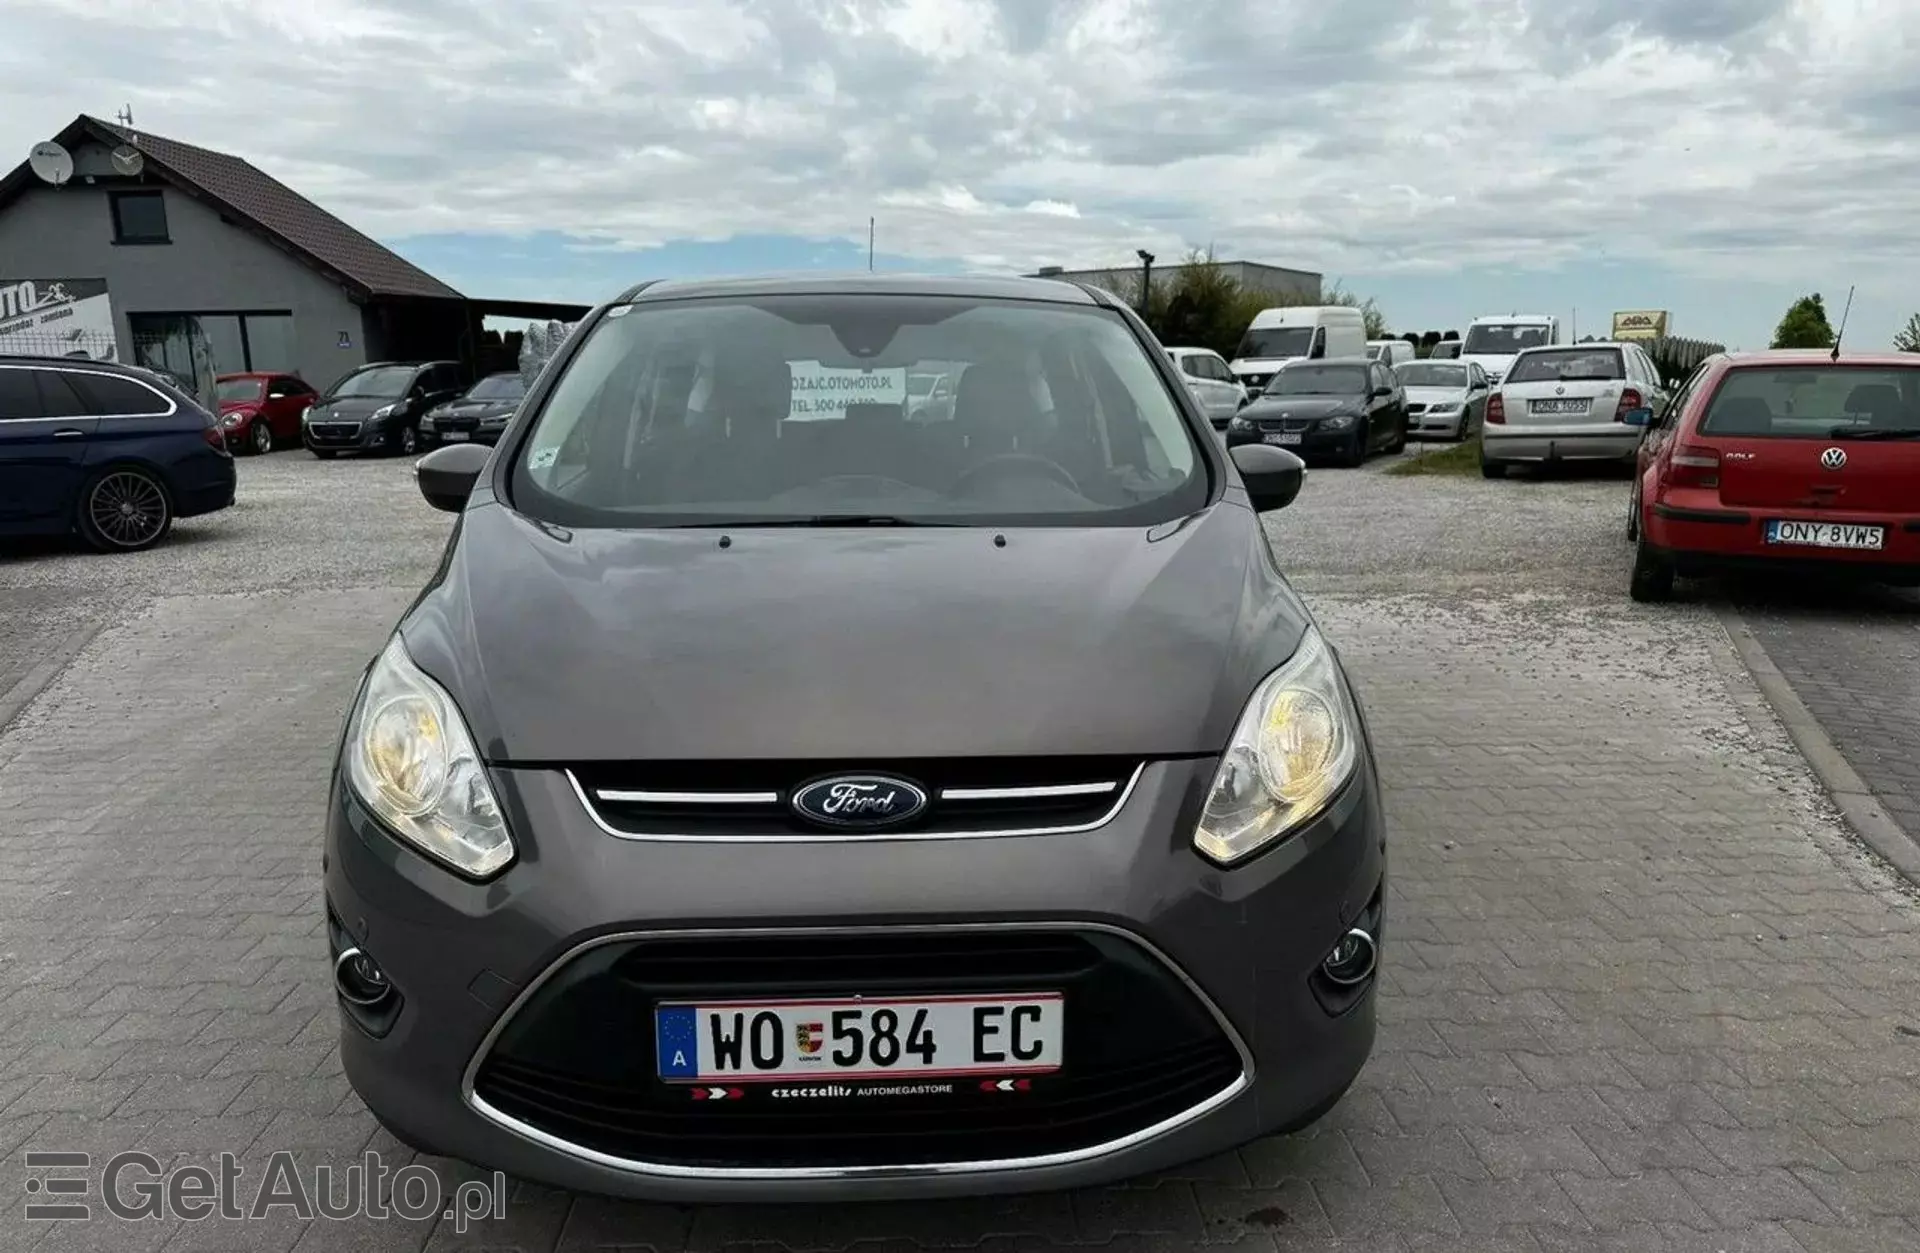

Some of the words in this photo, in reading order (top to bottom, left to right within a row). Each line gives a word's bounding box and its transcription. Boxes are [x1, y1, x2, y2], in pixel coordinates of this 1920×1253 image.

[1780, 523, 1823, 541] ONY
[1830, 526, 1880, 545] 8VW5
[823, 783, 896, 813] Ford
[710, 1011, 784, 1070] WO
[831, 1007, 937, 1066] 584
[973, 1005, 1043, 1062] EC
[672, 1050, 687, 1067] A
[771, 1085, 852, 1098] czeczelits
[857, 1084, 953, 1096] AUTOMEGASTORE
